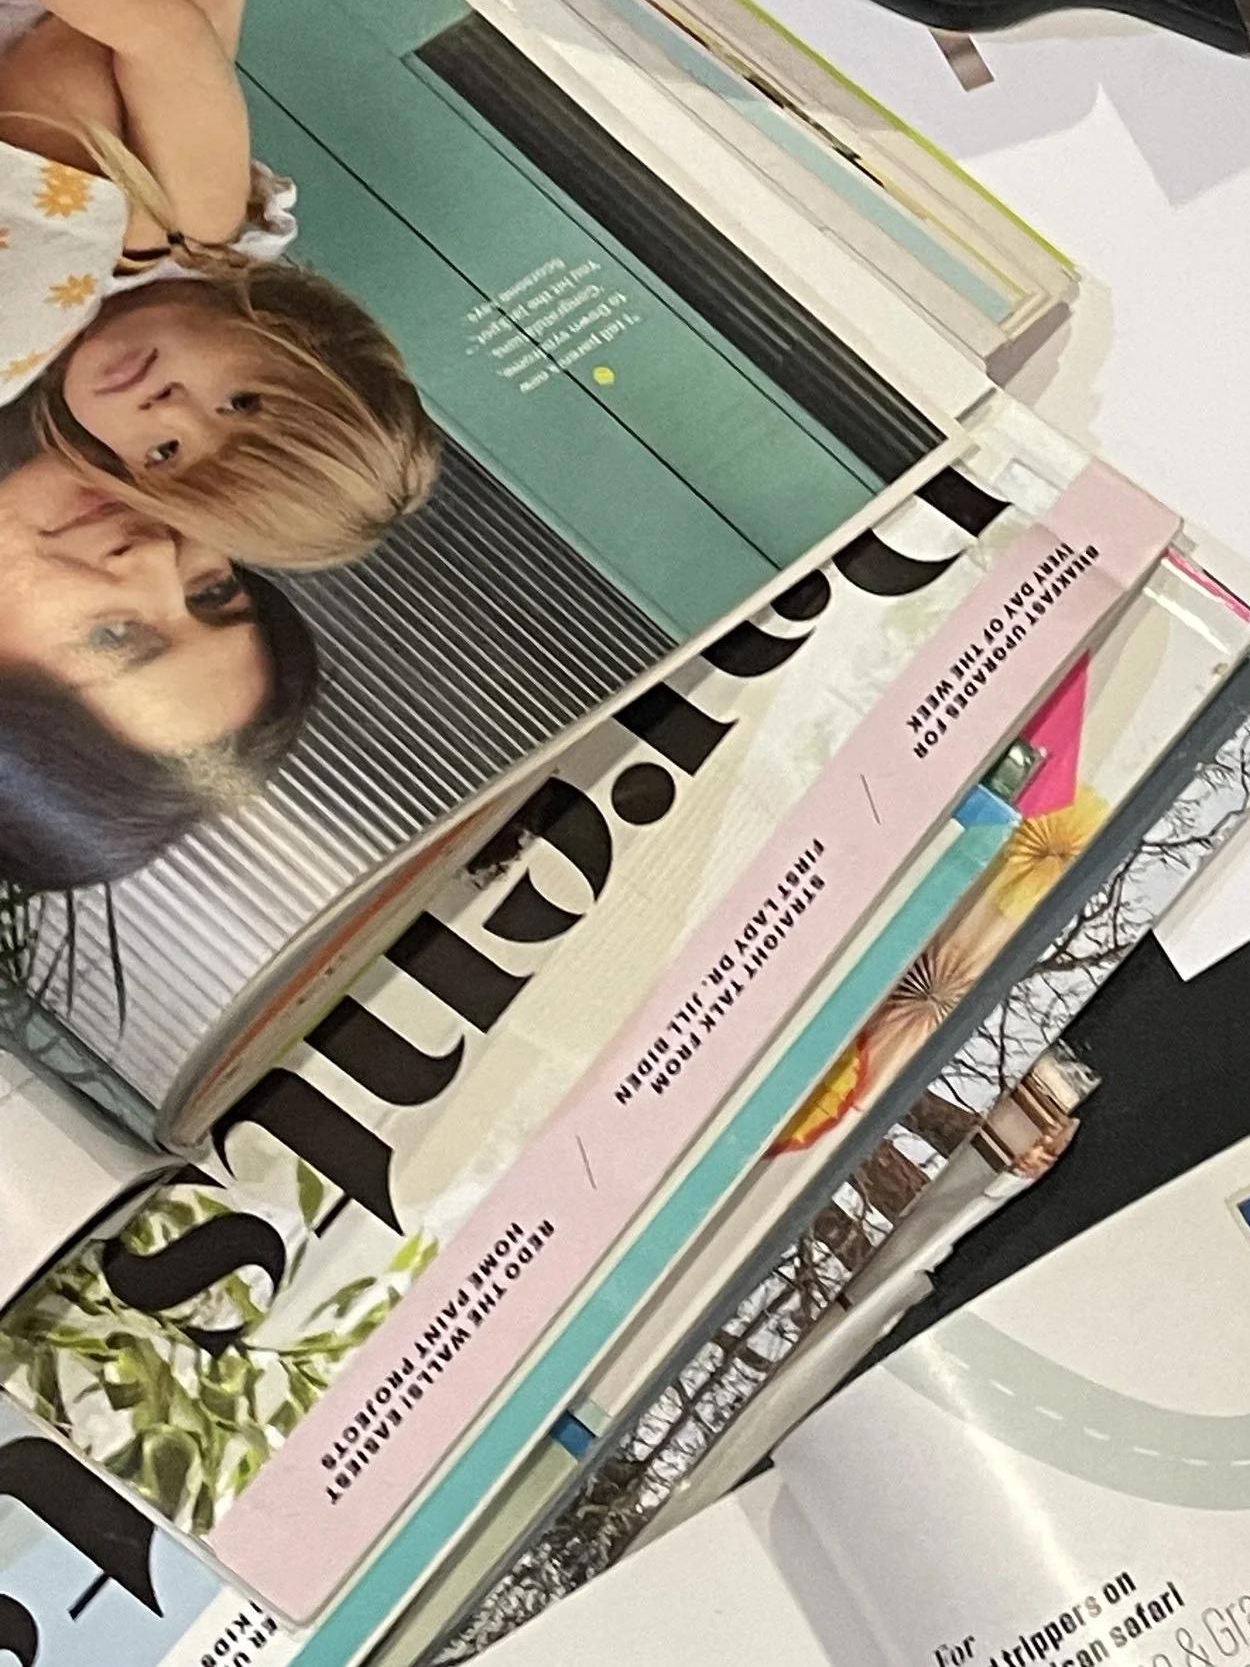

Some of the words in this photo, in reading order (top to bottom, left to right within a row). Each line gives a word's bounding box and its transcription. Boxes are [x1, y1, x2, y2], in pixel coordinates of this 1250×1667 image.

[1004, 582, 1034, 619] DAY
[984, 619, 1003, 643] OF
[951, 644, 984, 680] THE
[907, 680, 953, 732] WEEK
[914, 718, 946, 758] FOR
[104, 465, 1015, 1359] rents
[735, 899, 778, 954] LADY
[702, 955, 734, 985] DR.
[668, 994, 702, 1034] JILL
[700, 981, 743, 1032] TALK
[616, 1038, 668, 1104] BIDEN
[651, 1032, 701, 1094] FROM
[469, 1223, 523, 1288] HOME
[506, 1220, 554, 1279] REDO
[415, 1289, 469, 1358] PAINT
[468, 1283, 506, 1326] THE
[1104, 1573, 1136, 1604] on
[1107, 1581, 1187, 1650] safari
